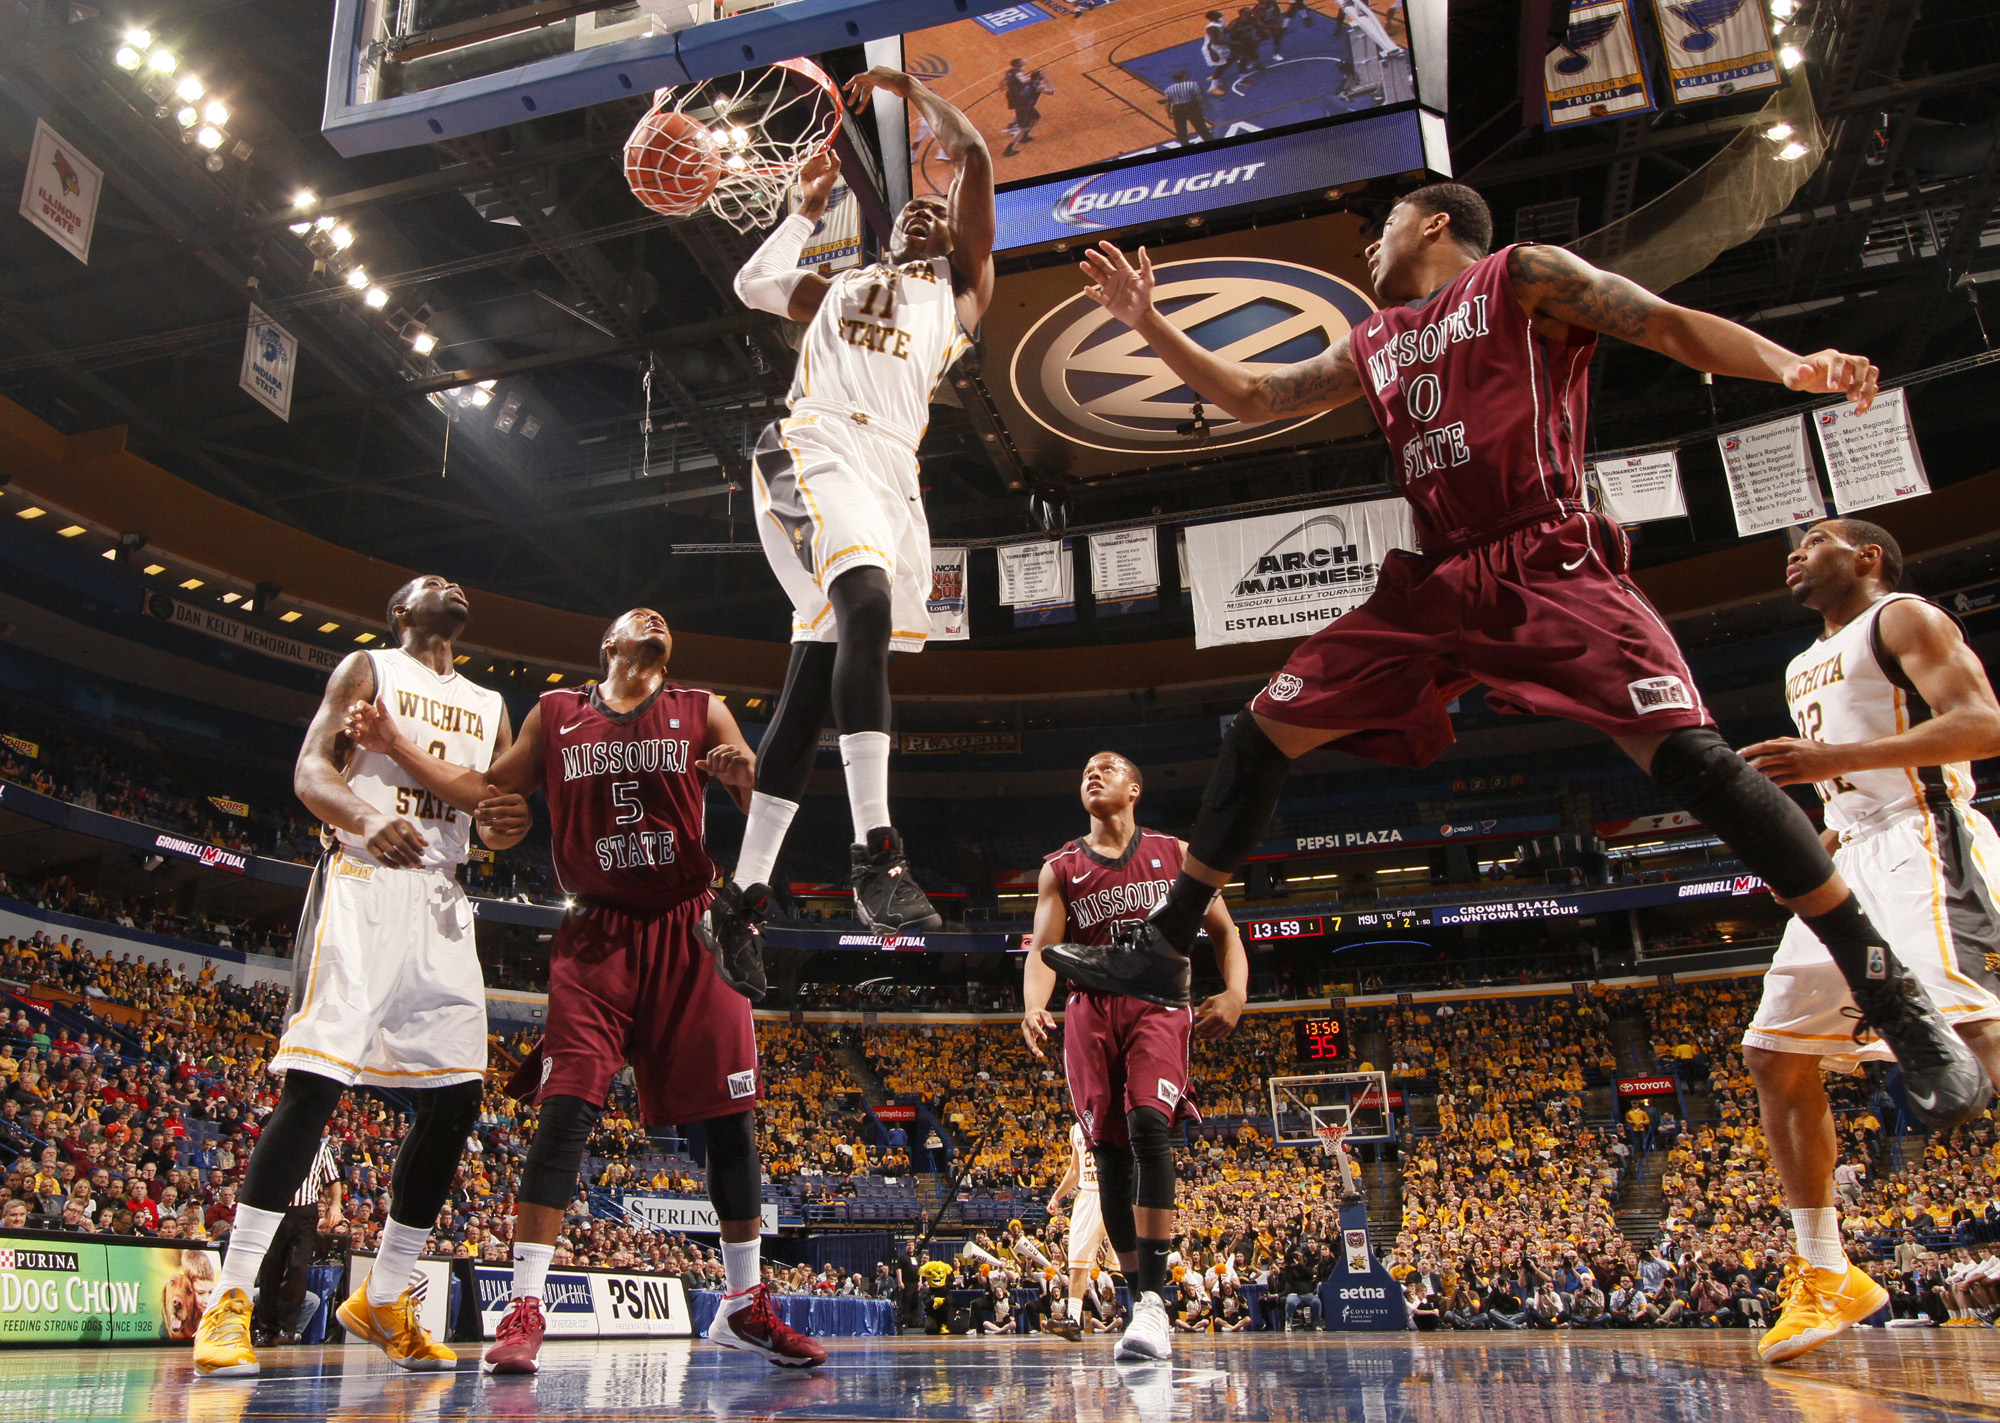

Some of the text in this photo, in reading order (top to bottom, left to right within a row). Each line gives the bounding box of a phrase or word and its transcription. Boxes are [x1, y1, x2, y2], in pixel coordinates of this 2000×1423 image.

[1679, 63, 1770, 87] CHAMPIONS
[1566, 88, 1621, 107] TROPHY
[1070, 161, 1266, 215] BUD LIGHT
[38, 186, 82, 228] ILLINOIS
[42, 203, 74, 235] STATE
[800, 246, 859, 265] HAMPIONS
[820, 239, 858, 253] DIVISION
[859, 278, 897, 320] 11
[253, 361, 282, 392] INDIANA
[255, 375, 278, 399] STATE
[1745, 424, 1800, 443] Championships
[1823, 418, 1892, 440] 2007 Men's Regional
[1845, 435, 1864, 444] Men's
[1847, 444, 1877, 454] Women's
[1879, 438, 1895, 447] Final
[1896, 435, 1911, 443] Four
[1403, 420, 1470, 486] STTE
[1764, 444, 1792, 456] Regional
[1766, 452, 1794, 465] Regional
[1850, 455, 1869, 463] Men's
[1870, 447, 1899, 459] Regional
[1602, 463, 1670, 477] TOURNAMENT CHAMPIONS
[1768, 461, 1795, 473] Regional
[1878, 456, 1903, 466] Rounds
[1751, 475, 1779, 485] Women's
[1780, 471, 1795, 479] Final
[1835, 466, 1906, 488] 2014 2nd/3rd Rounds
[1774, 486, 1802, 498] Regional
[1776, 499, 1792, 507] Final
[1793, 495, 1808, 503] Four
[1849, 495, 1875, 506] Hosted
[1750, 519, 1775, 530] Hosted
[936, 564, 962, 572] NCAA
[1254, 543, 1359, 577] ARCH
[1235, 562, 1381, 598] MADNESS
[1226, 584, 1376, 610] MISSOURI VALLEY TOURNAMEN
[930, 604, 951, 612] Louis
[1225, 606, 1342, 631] ESTABLISHED
[176, 604, 200, 626] DAN
[206, 616, 240, 639] KELLY
[243, 628, 302, 660] MEMORIAL
[1633, 682, 1689, 708] VALLEY
[397, 689, 484, 742] WICHITA
[562, 739, 690, 782] MISSOURI
[612, 781, 644, 825] 5
[1296, 825, 1473, 850] PEPSI PLAZA pepsi
[155, 835, 203, 857] GRINNELL
[200, 845, 247, 869] MUTUAL
[595, 831, 675, 871] STATE
[1678, 880, 1732, 897] GRINNELL
[1442, 905, 1579, 924] DOWNTOWN ST. LOUIS
[1459, 900, 1558, 915] CROWNE PLAZA
[1253, 920, 1300, 939] 13:59
[1331, 916, 1342, 932] 7
[1358, 914, 1378, 926] MSU
[1381, 912, 1396, 921] TOL
[1396, 910, 1416, 918] Fouls
[1403, 918, 1411, 928] 2
[839, 935, 882, 946] GRINNELL
[881, 936, 925, 950] MUTUAL
[1305, 1020, 1340, 1036] 13:58
[1309, 1035, 1337, 1059] 35
[1634, 1081, 1672, 1091] TOYOTA
[631, 1199, 719, 1230] STERLING
[16, 1252, 77, 1270] PURINA
[0, 1272, 141, 1315] DOG CHOW
[479, 1279, 508, 1301] BRYAN
[543, 1283, 589, 1305] BRYAN CAVE
[607, 1278, 670, 1320] PSAV
[1340, 1285, 1386, 1299] aetna
[3, 1320, 153, 1332] FEEDING STRONG DOGS SINCE 1926
[551, 1315, 590, 1329] bryancave.com
[615, 1322, 674, 1331] PRESENTATION SERVICES
